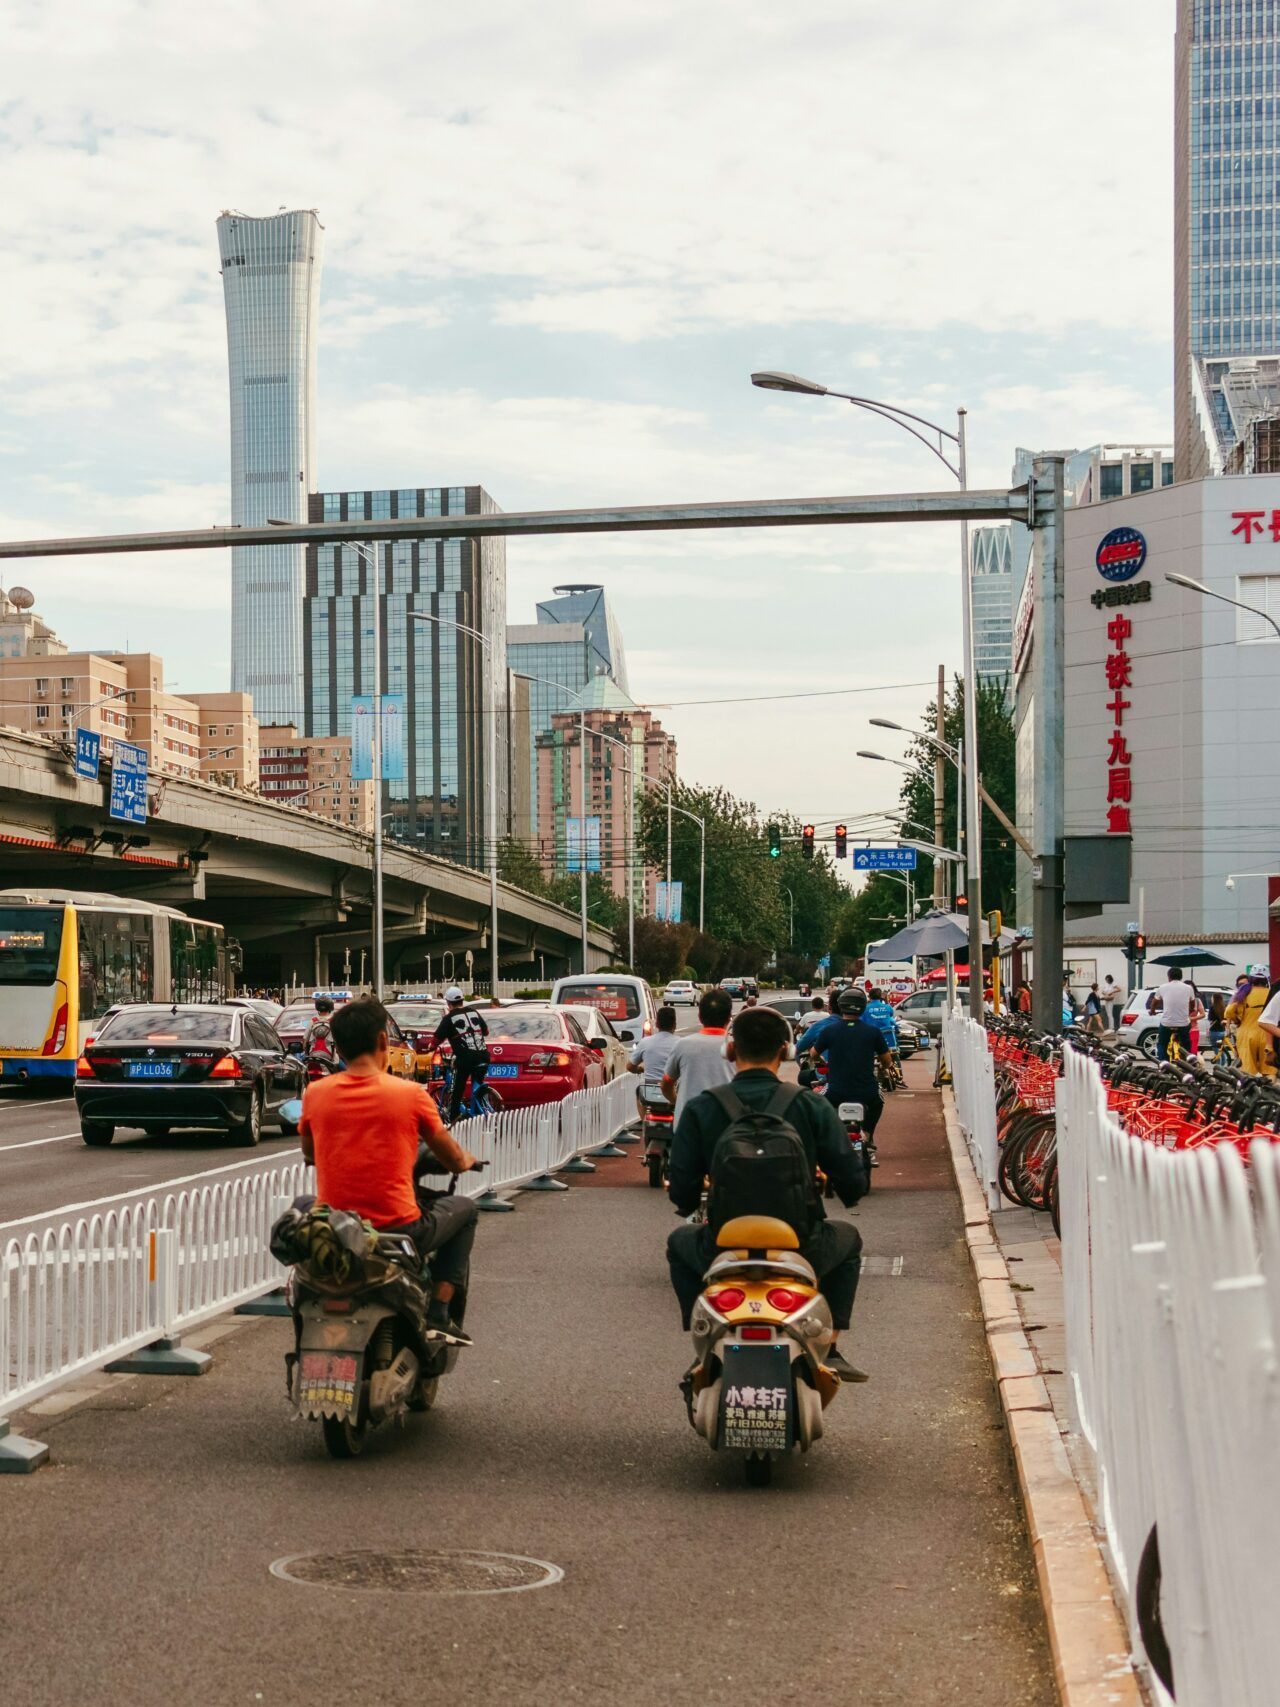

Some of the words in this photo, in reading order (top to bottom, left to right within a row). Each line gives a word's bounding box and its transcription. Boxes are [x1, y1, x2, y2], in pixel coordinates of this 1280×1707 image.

[1090, 580, 1153, 609] 中国铁建
[869, 851, 913, 860] 东三环北路
